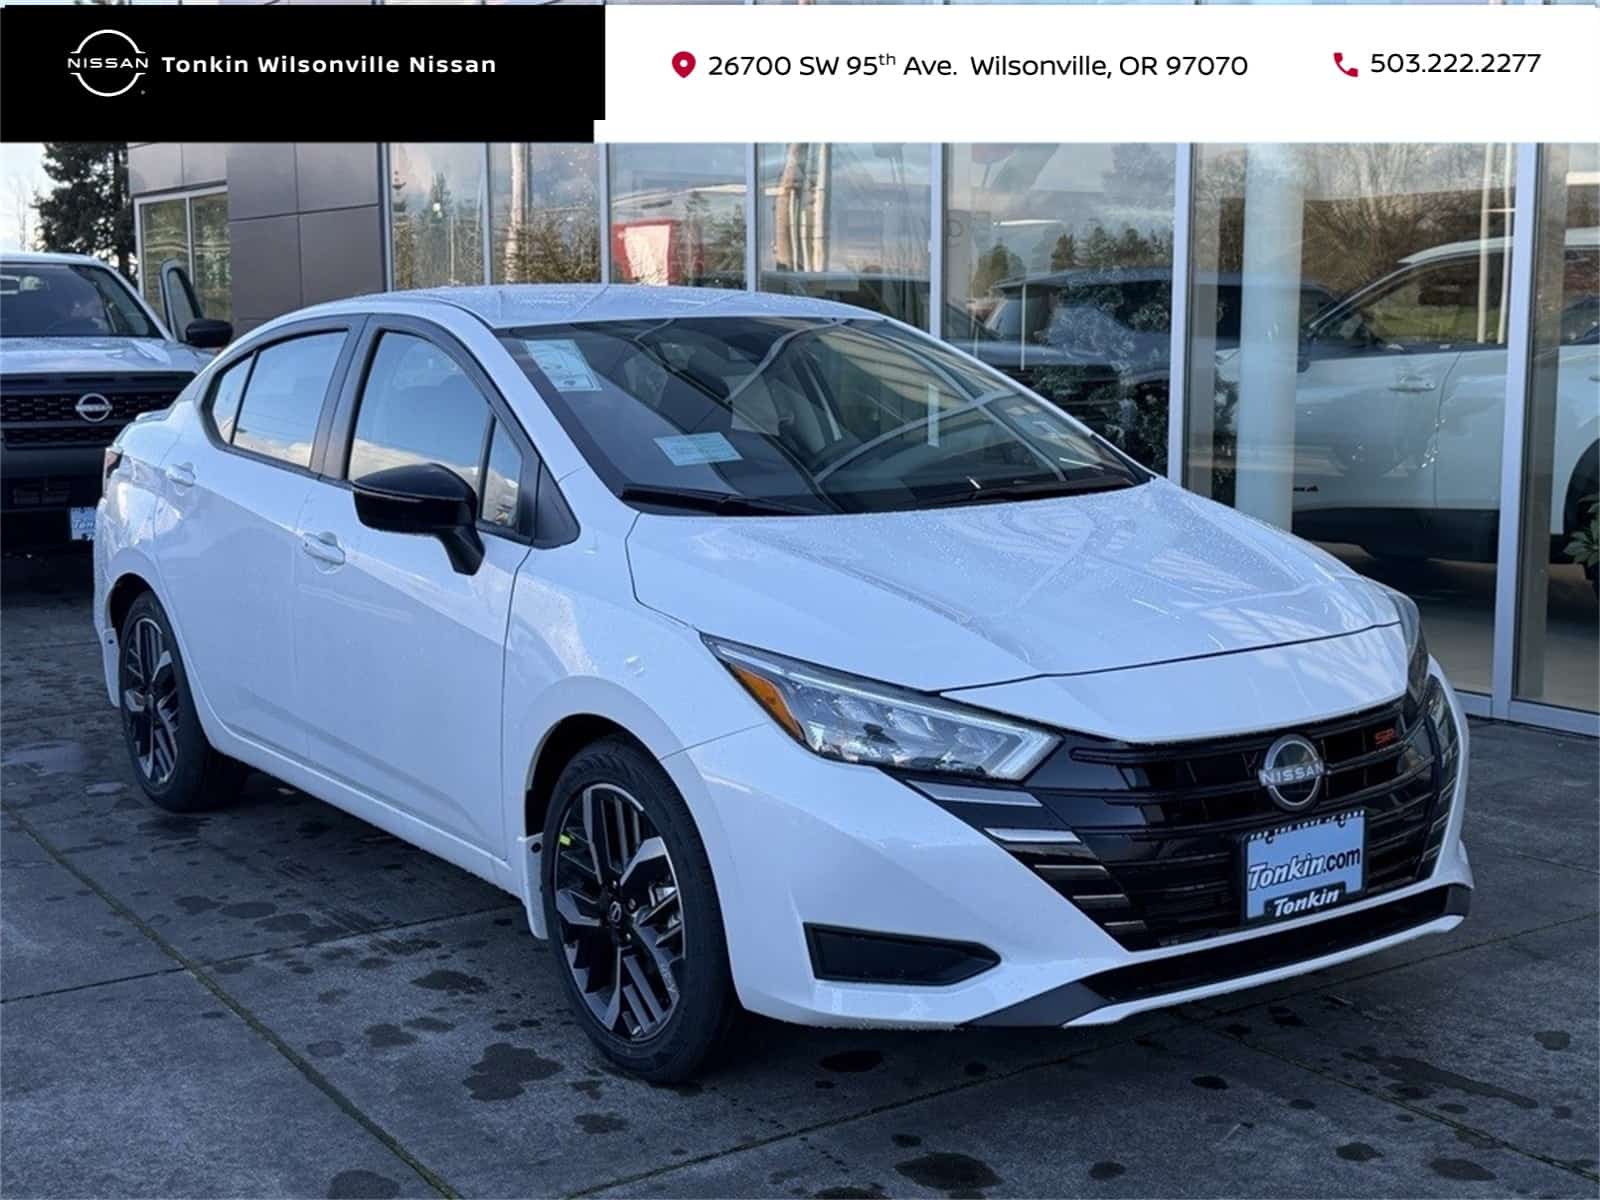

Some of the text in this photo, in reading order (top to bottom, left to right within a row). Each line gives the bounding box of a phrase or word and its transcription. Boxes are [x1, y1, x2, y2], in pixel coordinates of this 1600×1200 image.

[1261, 761, 1324, 784] NISSAN
[1249, 848, 1360, 889] Tonkin.com
[1274, 888, 1339, 916] Tonkin
